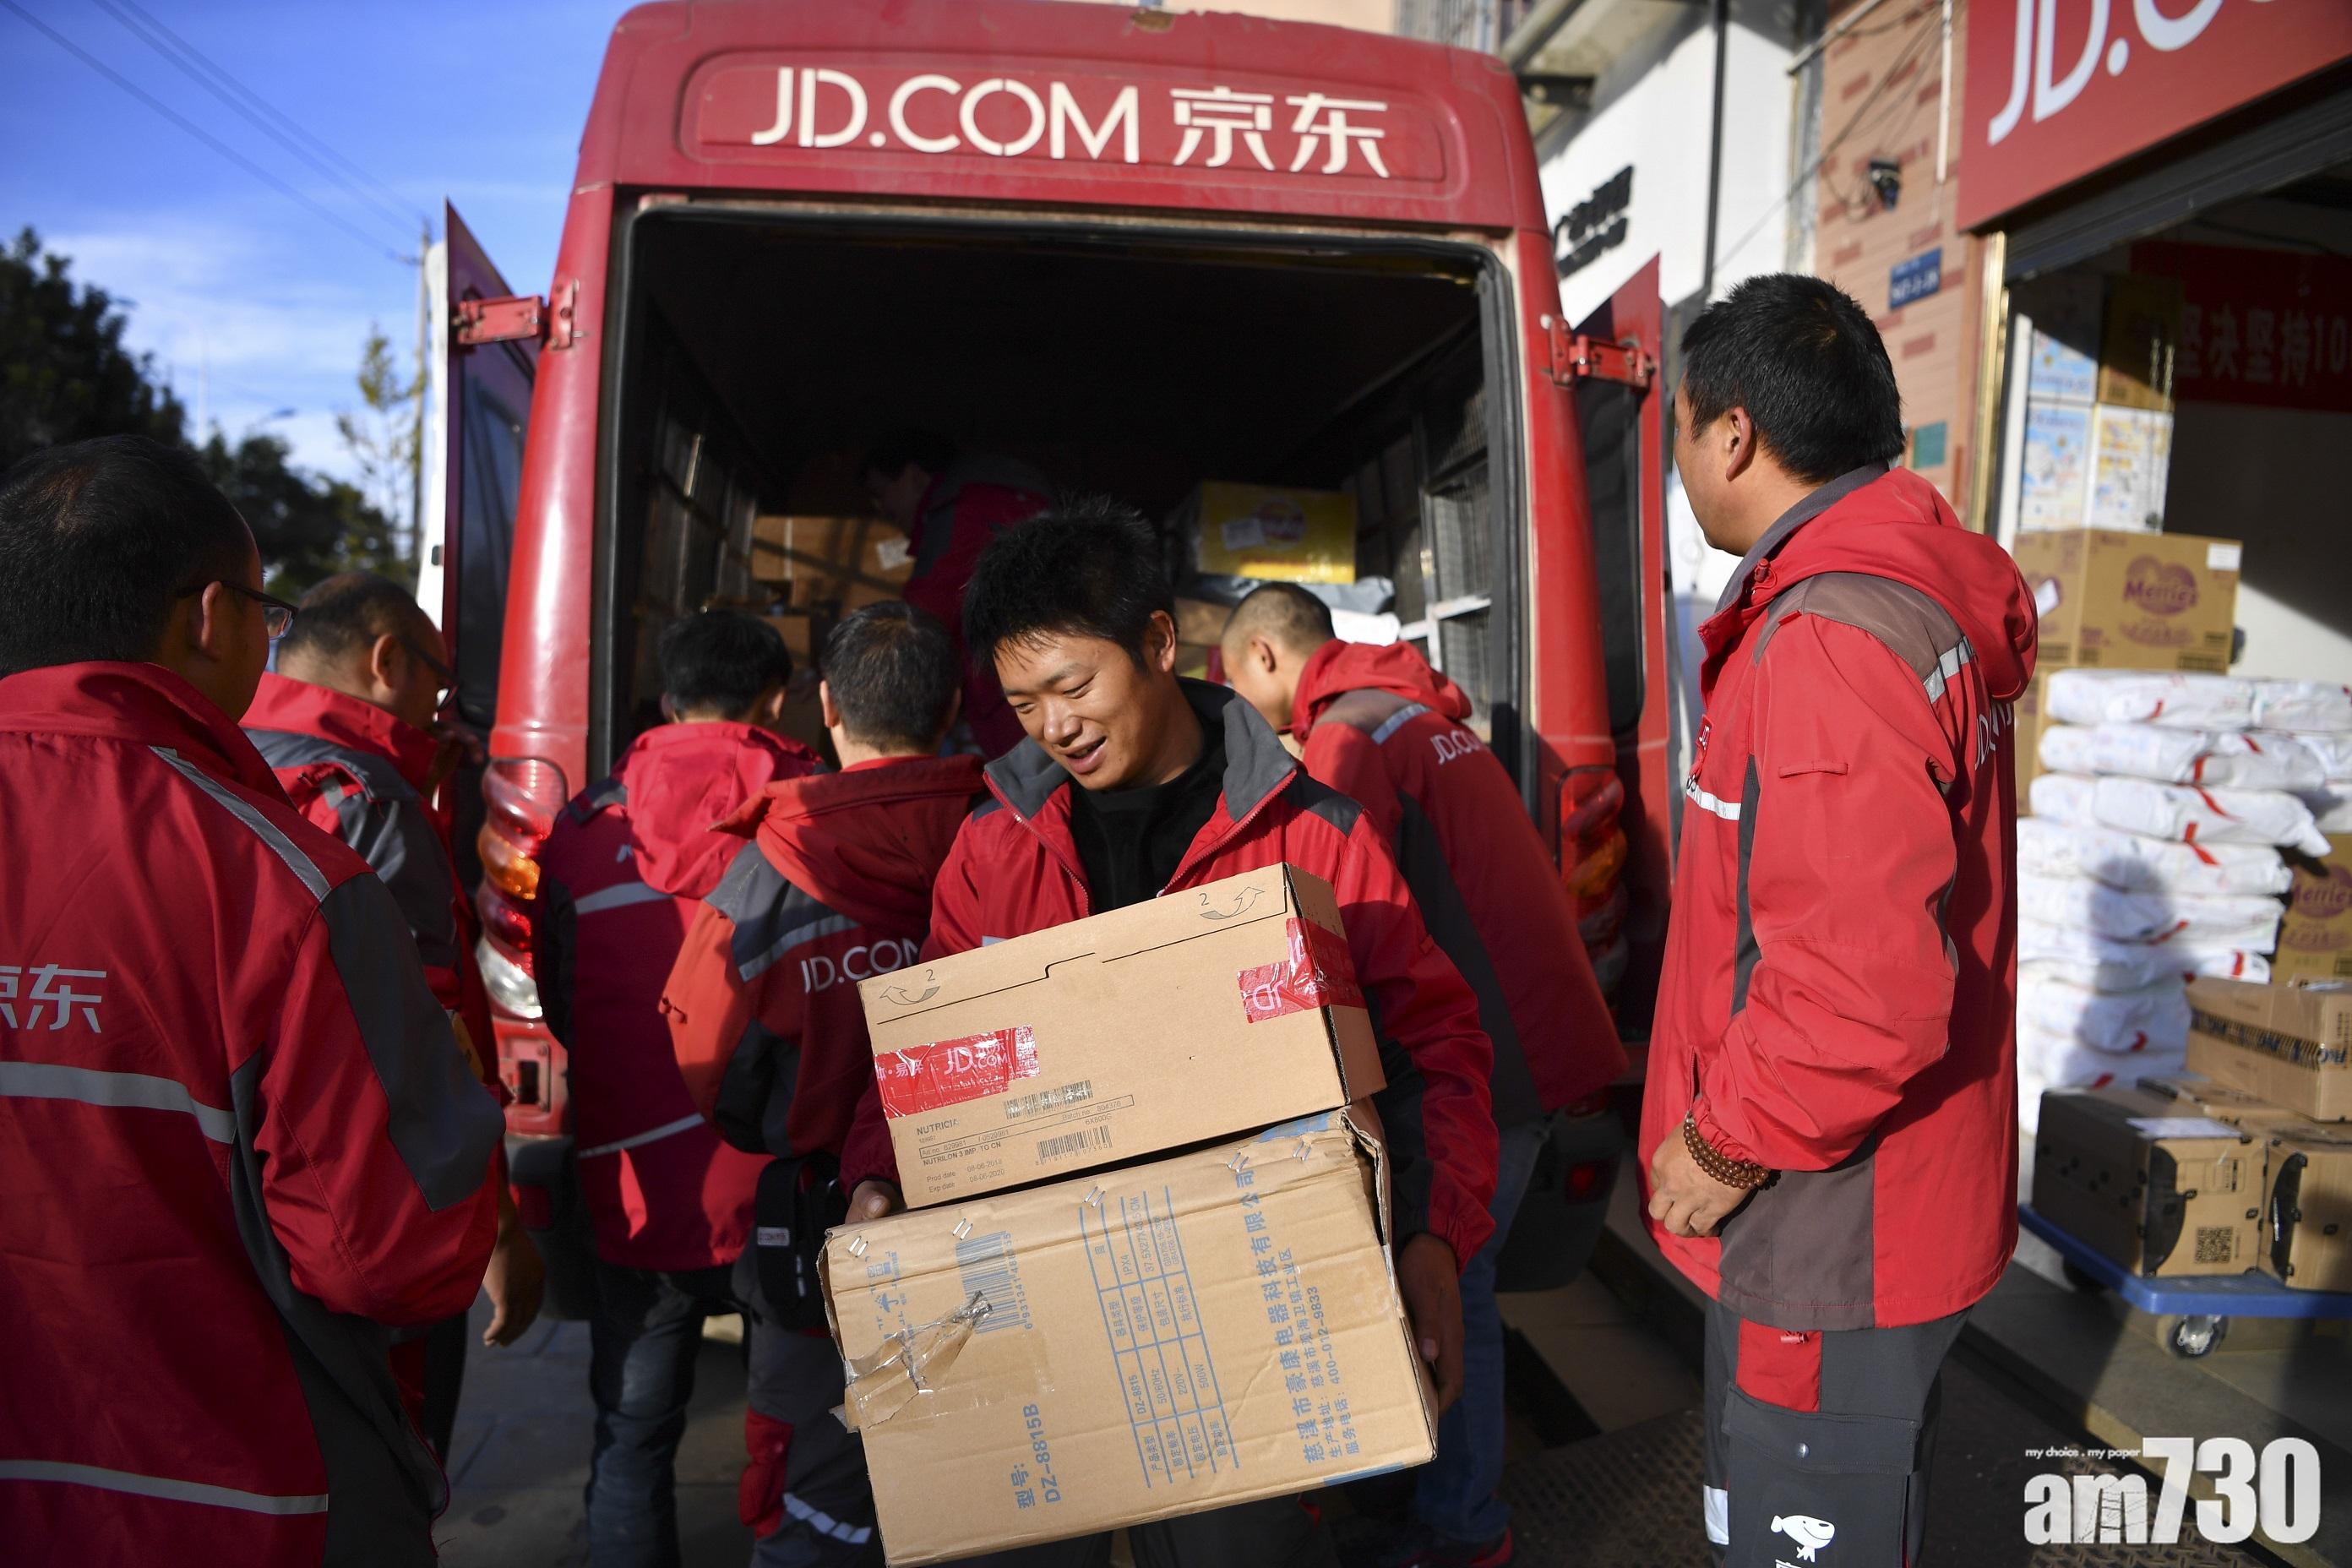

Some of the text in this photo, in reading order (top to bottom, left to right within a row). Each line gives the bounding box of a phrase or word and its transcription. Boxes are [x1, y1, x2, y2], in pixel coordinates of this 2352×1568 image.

[751, 67, 1388, 177] JD.COM 京东
[1200, 893, 1209, 906] 2
[926, 969, 935, 982] 2
[0, 964, 107, 1033] 东
[917, 1119, 960, 1135] NUTRICIA
[923, 1152, 958, 1167] NUTRILON
[1120, 1254, 1133, 1276] IPX4
[1235, 1170, 1325, 1463] 慈溪市豪康电器科技有限公司
[1307, 1286, 1340, 1385] 400-012-9833
[1129, 1375, 1146, 1414] DZ-8815
[1023, 1403, 1061, 1503] DZ-8815B
